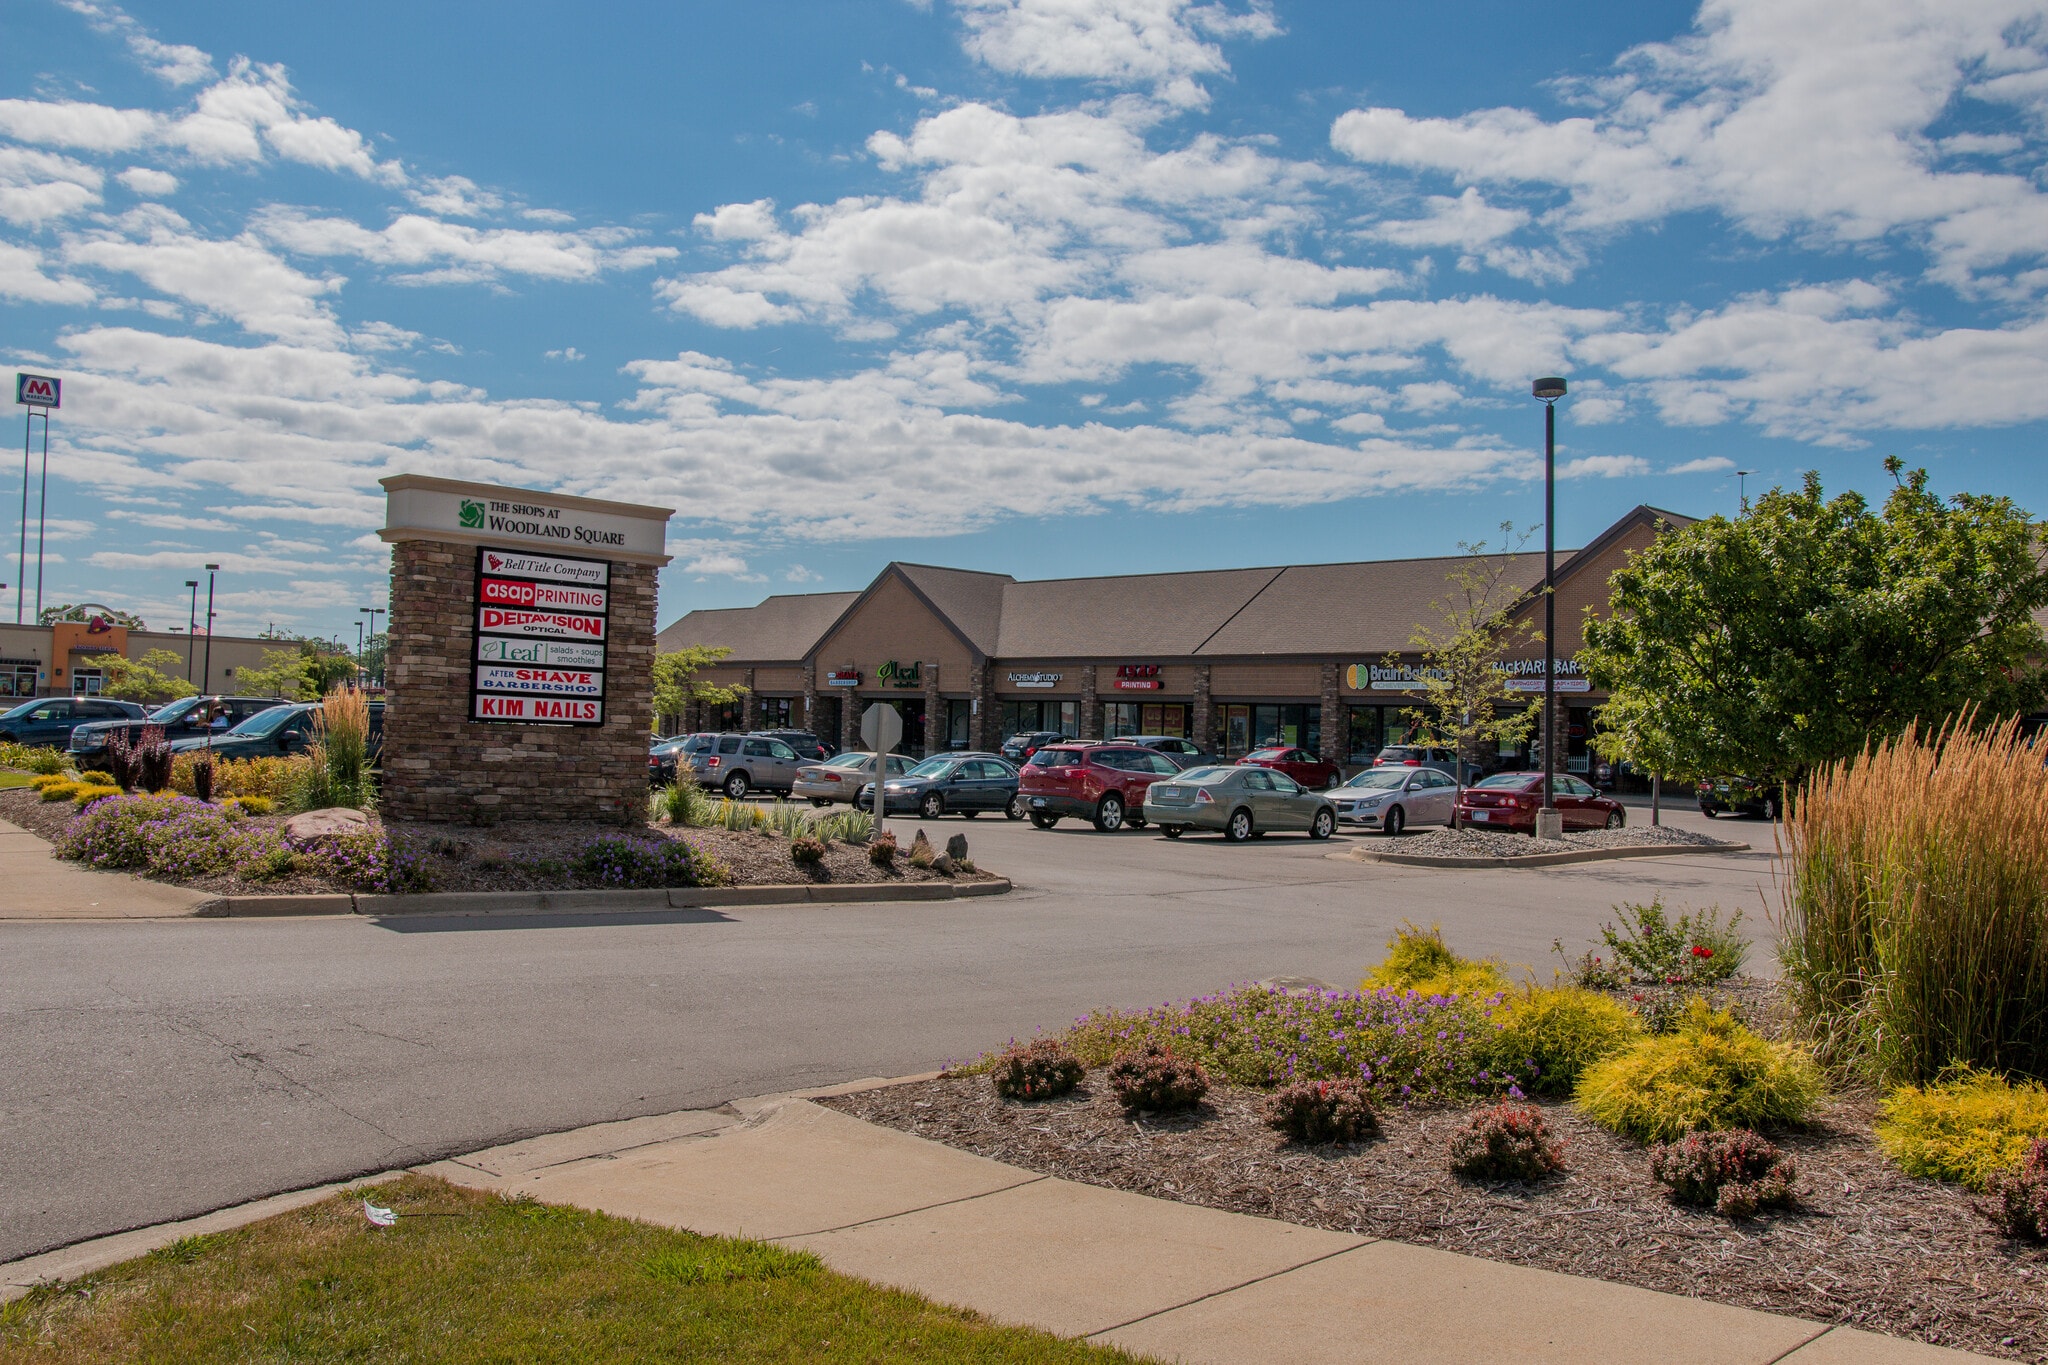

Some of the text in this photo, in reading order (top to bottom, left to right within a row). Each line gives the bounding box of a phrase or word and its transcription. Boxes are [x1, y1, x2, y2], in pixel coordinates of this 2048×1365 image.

[28, 380, 51, 396] M
[489, 502, 560, 520] THE SHOPS AT
[489, 515, 625, 546] WOODLAND SQUARE
[504, 559, 601, 580] Bell Title Company
[486, 583, 603, 606] asap PRINTING
[484, 609, 601, 637] DELTAVISION
[523, 625, 566, 635] OPTICAL
[499, 640, 603, 662] Leaf salads soups
[557, 656, 595, 665] smoothies
[489, 669, 592, 684] AFTER SHAVE
[1116, 665, 1157, 678] ASAP
[1370, 664, 1401, 681] Brain
[483, 680, 597, 693] BARBERSHOP
[1121, 681, 1151, 689] PRINTING
[482, 698, 596, 720] KIM NAILS
